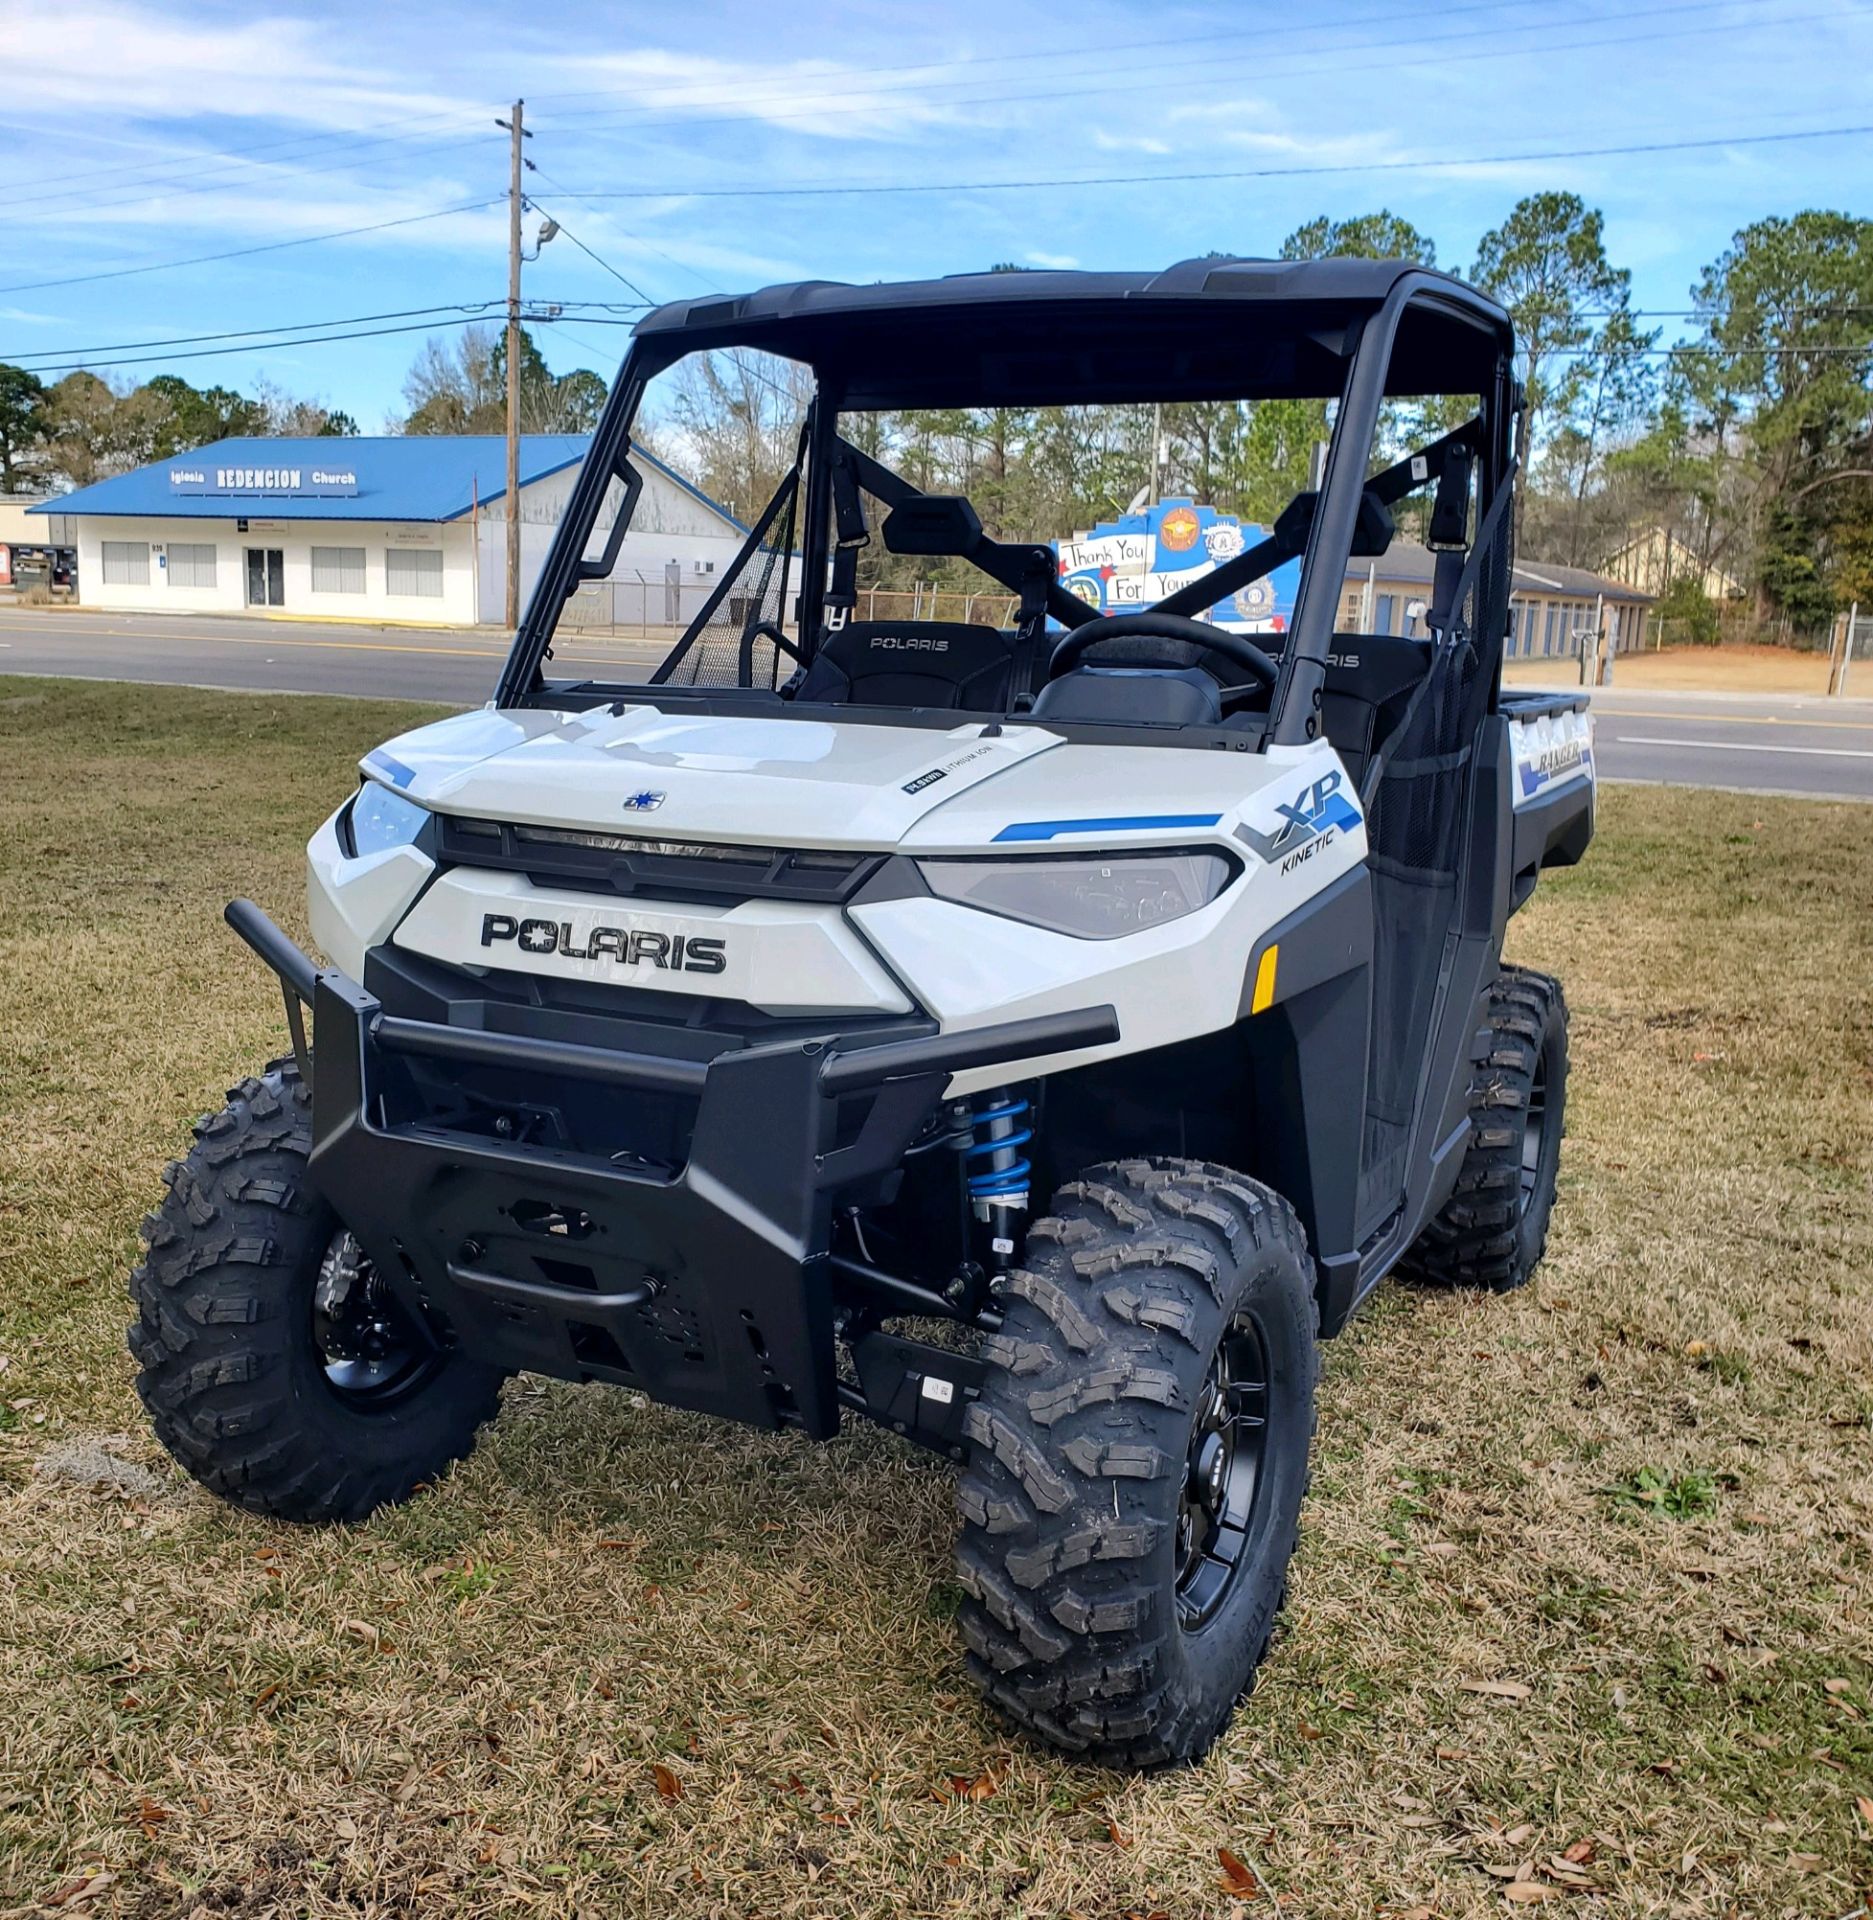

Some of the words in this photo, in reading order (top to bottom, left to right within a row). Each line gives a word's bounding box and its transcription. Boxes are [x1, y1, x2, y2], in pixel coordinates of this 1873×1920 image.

[171, 471, 205, 485] Iglesia
[217, 469, 301, 489] REDENCION
[312, 472, 356, 485] Church
[1061, 542, 1113, 567] Thank
[1116, 539, 1144, 560] You
[1116, 577, 1143, 600] For
[870, 637, 949, 652] POLARIS
[942, 753, 977, 773] LITHIUM
[975, 745, 993, 756] ION
[1539, 740, 1580, 773] RANGER
[1272, 769, 1342, 848] XP
[1281, 829, 1335, 877] KINETIC
[480, 913, 727, 975] POLARIS
